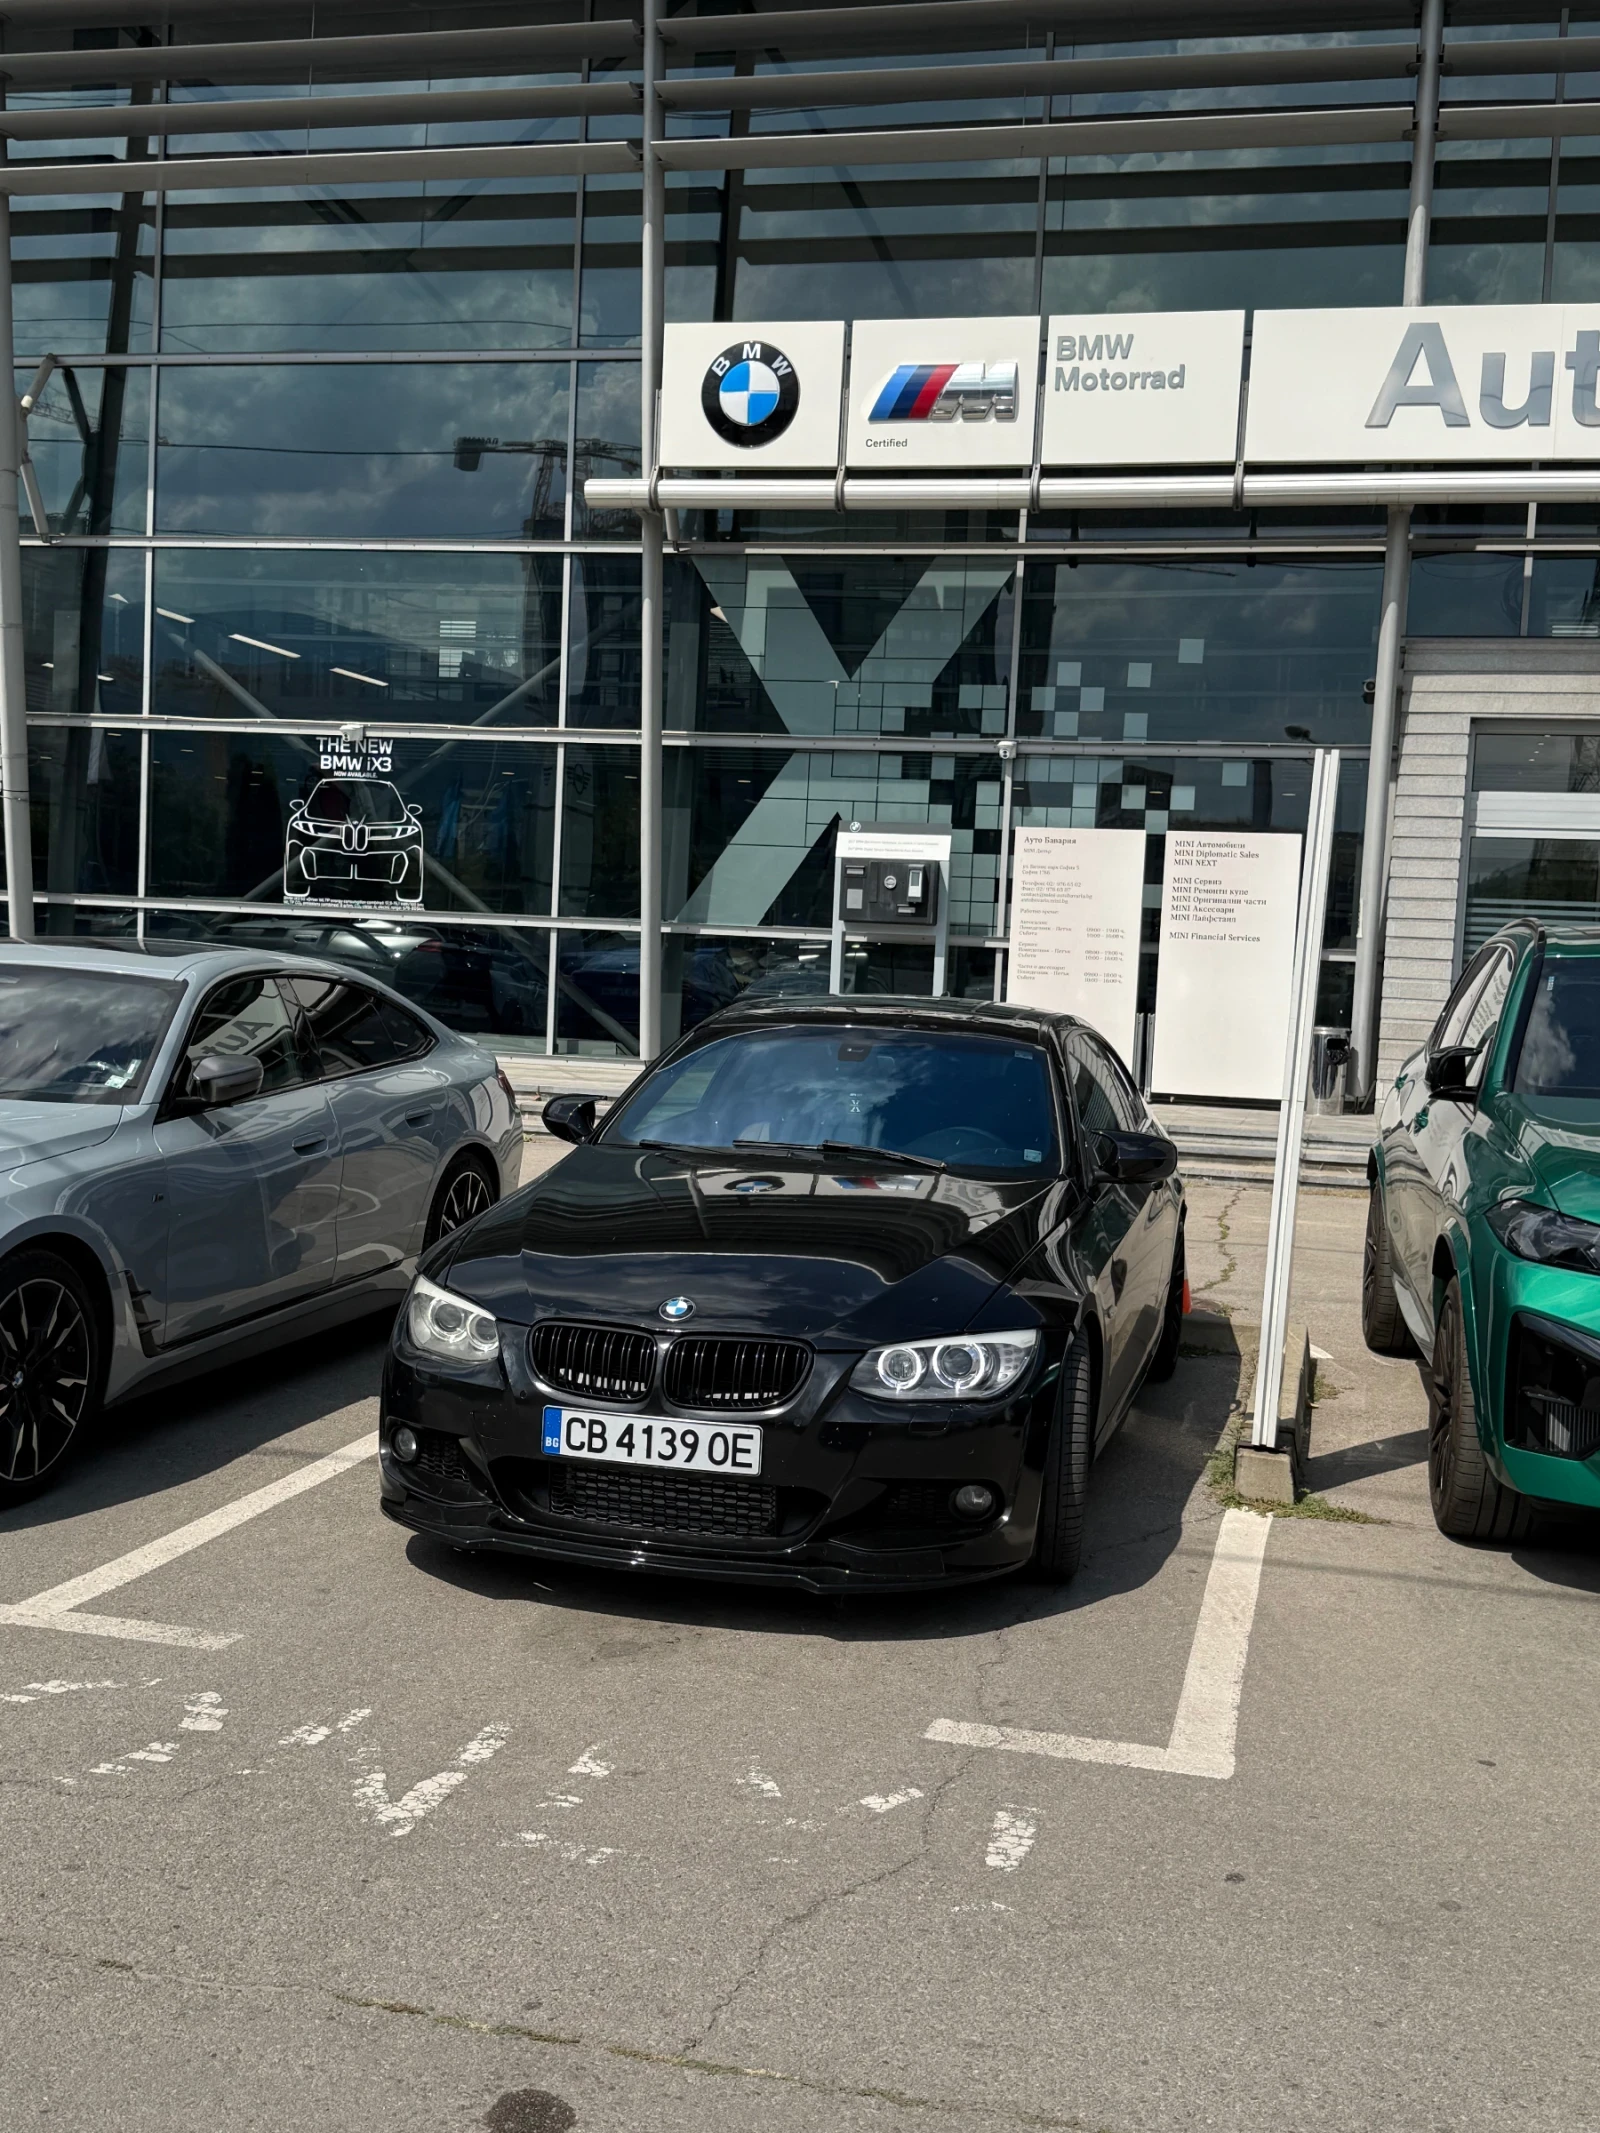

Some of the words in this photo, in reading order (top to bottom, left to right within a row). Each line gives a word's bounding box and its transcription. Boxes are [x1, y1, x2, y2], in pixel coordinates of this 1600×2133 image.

[1056, 333, 1134, 361] BMW
[711, 342, 793, 378] BMW
[1054, 364, 1186, 393] Motorrad
[865, 437, 909, 448] Certified
[316, 737, 351, 753] THE
[355, 738, 394, 754] NEW
[320, 755, 363, 771] BMW
[1024, 836, 1042, 844] Ауто
[1044, 837, 1076, 845] Бавария
[1196, 841, 1246, 849] Автомобили
[1196, 850, 1238, 858] Diplomatic
[1194, 878, 1222, 886] Сервиз
[1193, 896, 1242, 905] Оригинални
[1193, 905, 1234, 914] Аксесоари
[1192, 914, 1236, 924] Лайфстайл
[1191, 933, 1226, 941] Financial
[545, 1436, 559, 1448] BG
[565, 1417, 608, 1453] CB
[616, 1423, 700, 1463] 4139
